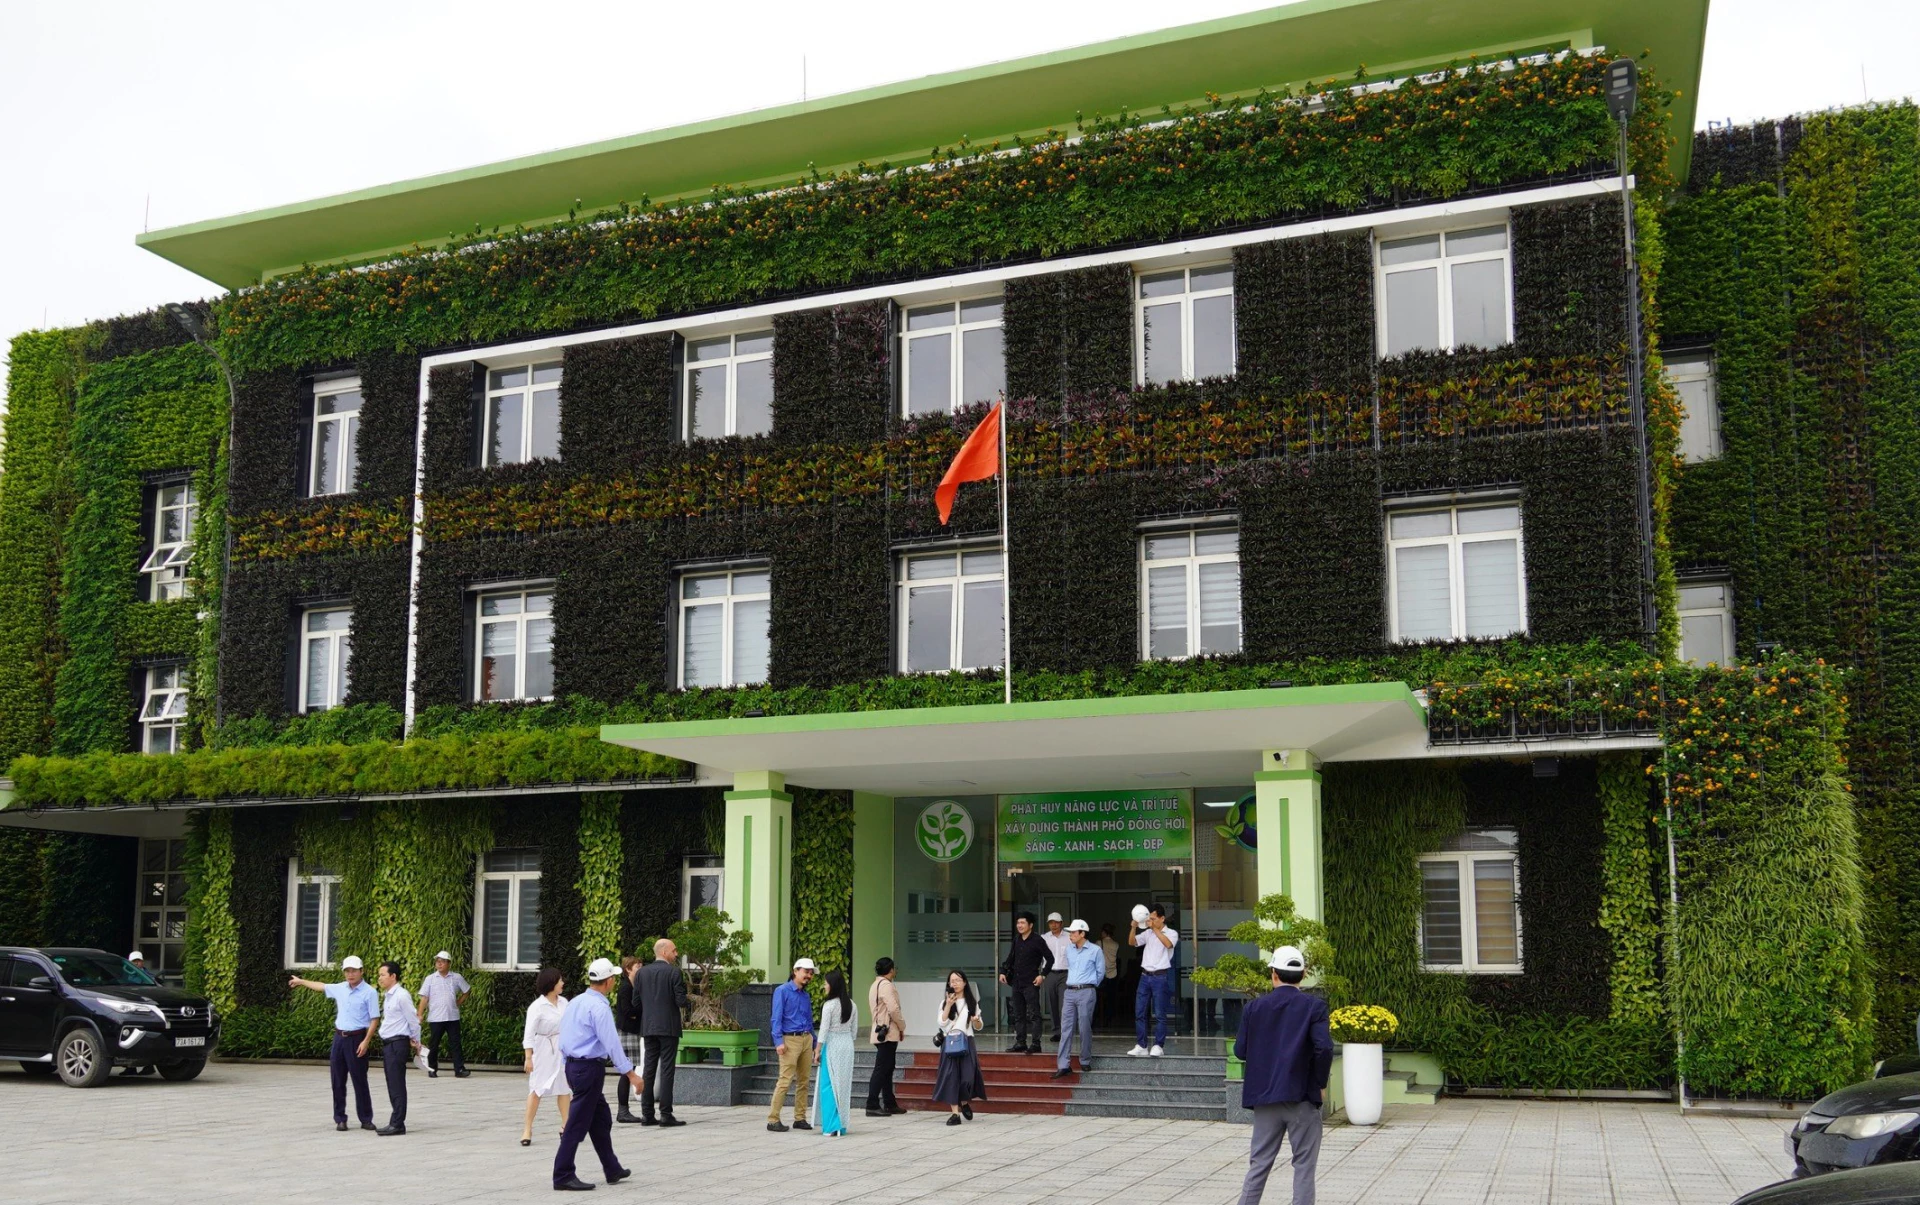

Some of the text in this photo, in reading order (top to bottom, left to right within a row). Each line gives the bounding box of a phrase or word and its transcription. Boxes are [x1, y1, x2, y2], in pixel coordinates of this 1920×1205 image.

[1011, 801, 1036, 814] PHÁT
[1041, 802, 1060, 813] HUY
[1064, 799, 1095, 813] NĂNG
[1123, 797, 1138, 810] VÀ
[1142, 797, 1157, 810] TRÍ
[1160, 796, 1178, 812] TUỆ
[1005, 821, 1026, 834] XÂY
[1063, 819, 1098, 832] THÀNH
[1102, 816, 1124, 830] PHỐ
[1025, 840, 1055, 852] SÁNG
[1064, 841, 1094, 851] XANH
[1104, 839, 1133, 853] SẠCH
[1143, 839, 1163, 853] ĐẸP
